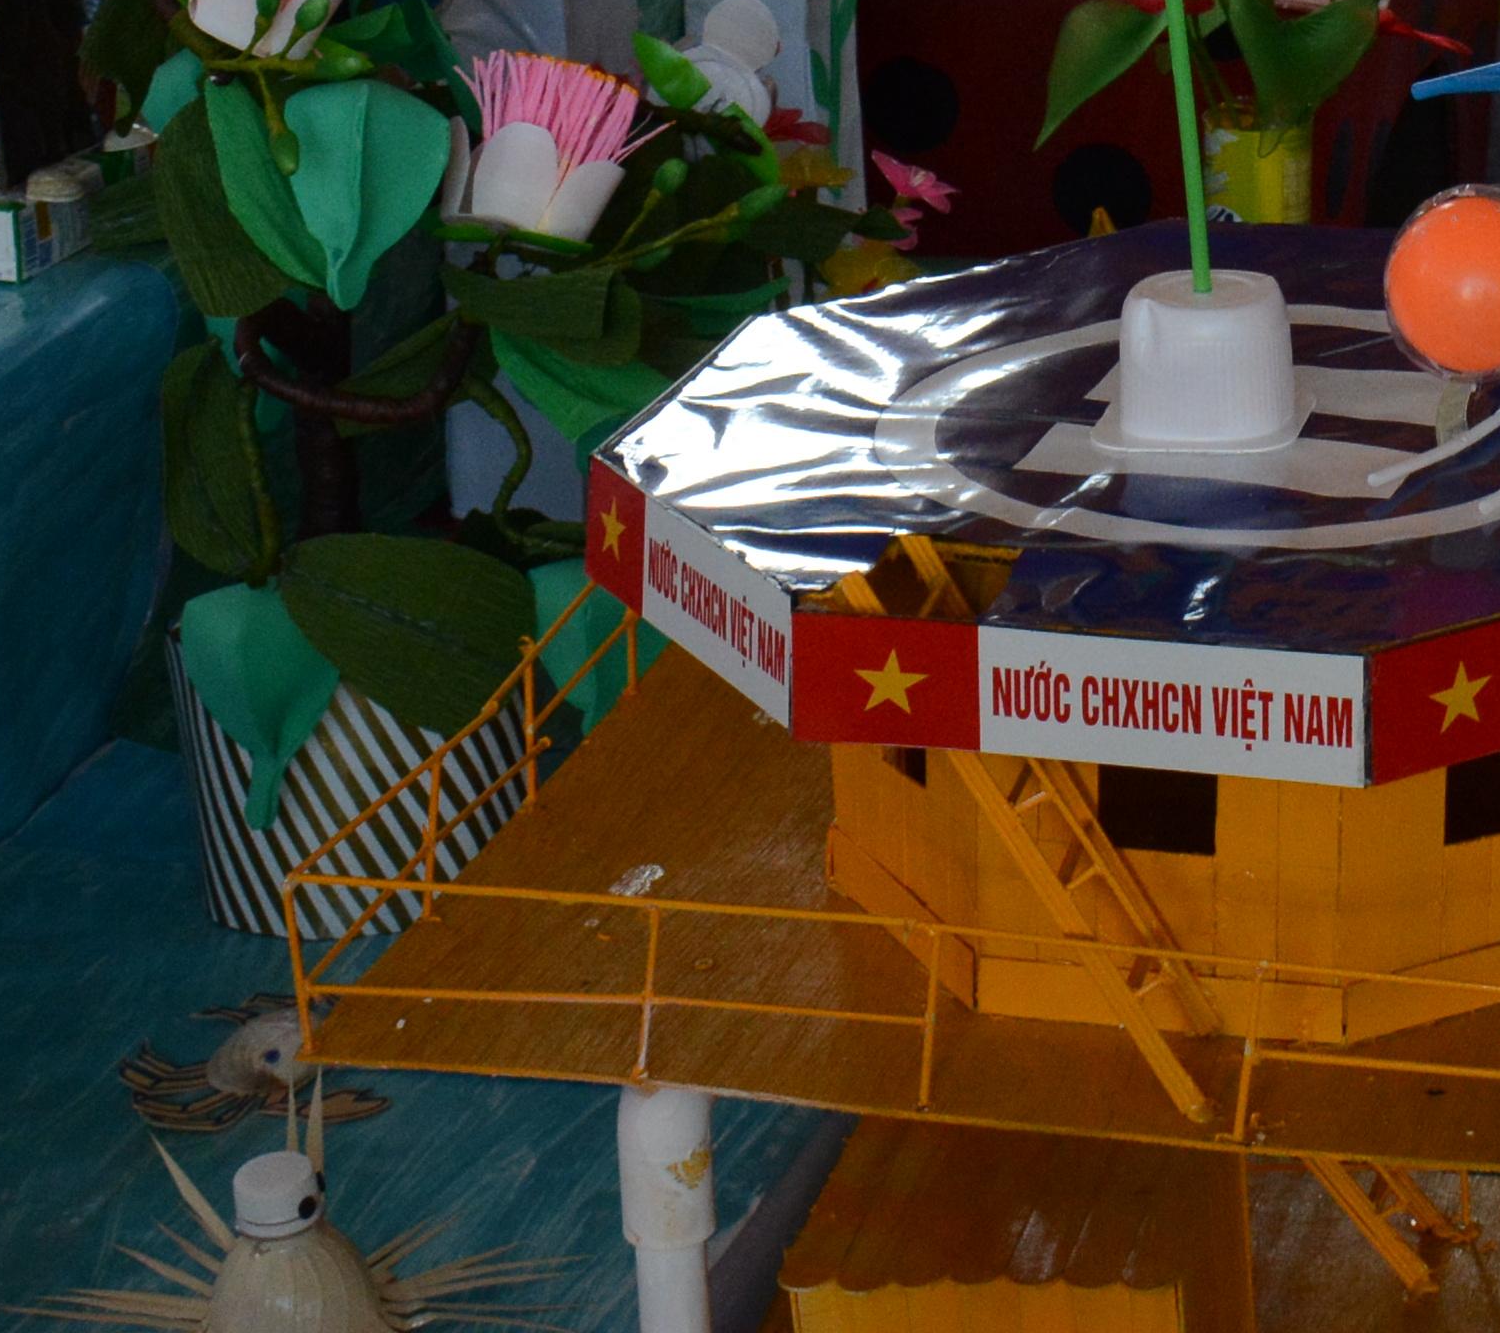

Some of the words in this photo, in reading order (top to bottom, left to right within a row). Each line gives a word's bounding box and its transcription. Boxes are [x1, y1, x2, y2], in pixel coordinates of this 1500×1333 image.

[648, 536, 678, 604] NƯỚC
[681, 561, 727, 641] CHXHCN
[730, 595, 755, 668] VIỆT
[757, 616, 786, 685] NAM
[992, 660, 1071, 724] NƯỚC
[1081, 675, 1201, 735] CHXHCN
[1211, 678, 1274, 751] VIỆT
[1283, 692, 1353, 748] NAM
